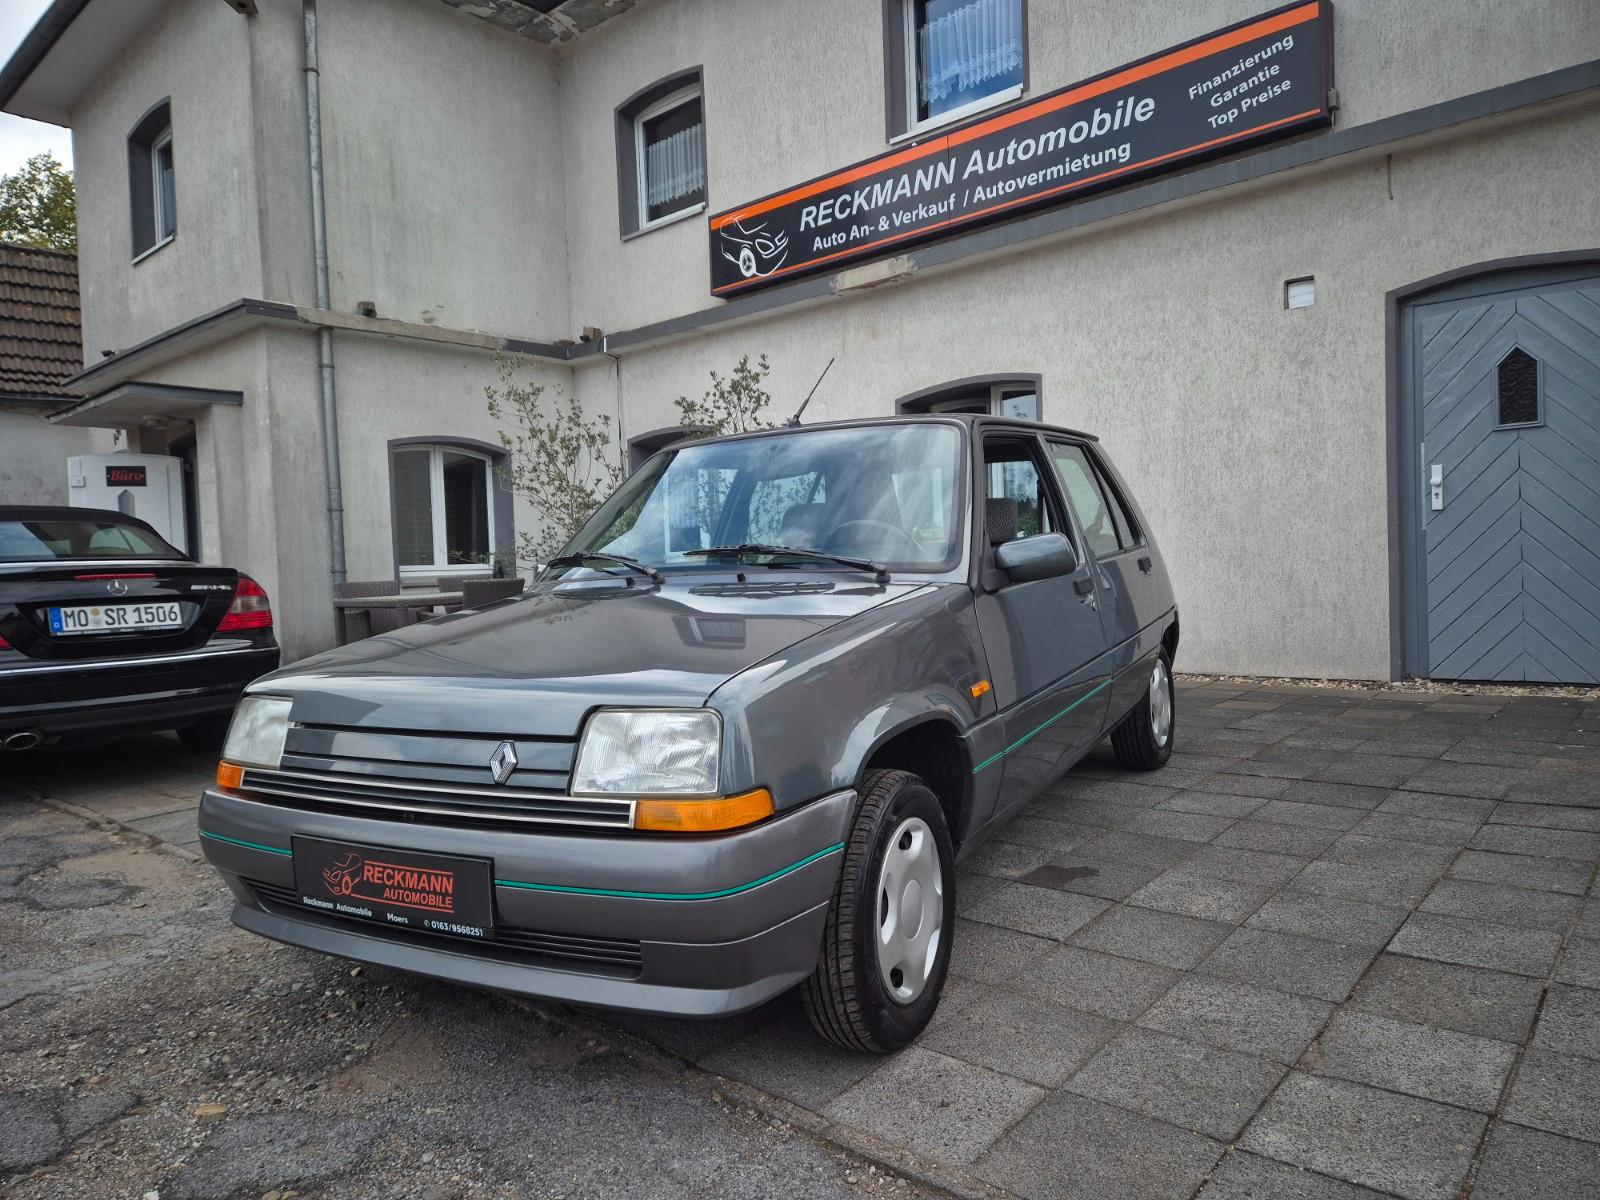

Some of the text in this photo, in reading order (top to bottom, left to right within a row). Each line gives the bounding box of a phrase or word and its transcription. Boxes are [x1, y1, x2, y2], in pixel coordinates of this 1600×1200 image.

[1188, 34, 1294, 100] Finanzierung
[1210, 64, 1280, 107] Garantie
[1207, 79, 1291, 129] Top Preise
[799, 96, 1156, 232] RECKMANN Automobile
[813, 230, 846, 252] Auto
[849, 224, 875, 241] An-
[878, 216, 890, 231] &
[892, 194, 956, 226] Verkauf
[973, 142, 1131, 203] Autovermietung
[111, 469, 142, 481] Büro
[63, 605, 178, 628] MO SR 1506
[363, 864, 454, 894] RECKMANN
[303, 896, 334, 910] Reckmann
[336, 903, 373, 917] Automobile
[386, 912, 409, 924] Moers
[383, 887, 453, 908] AUTOMOBILE
